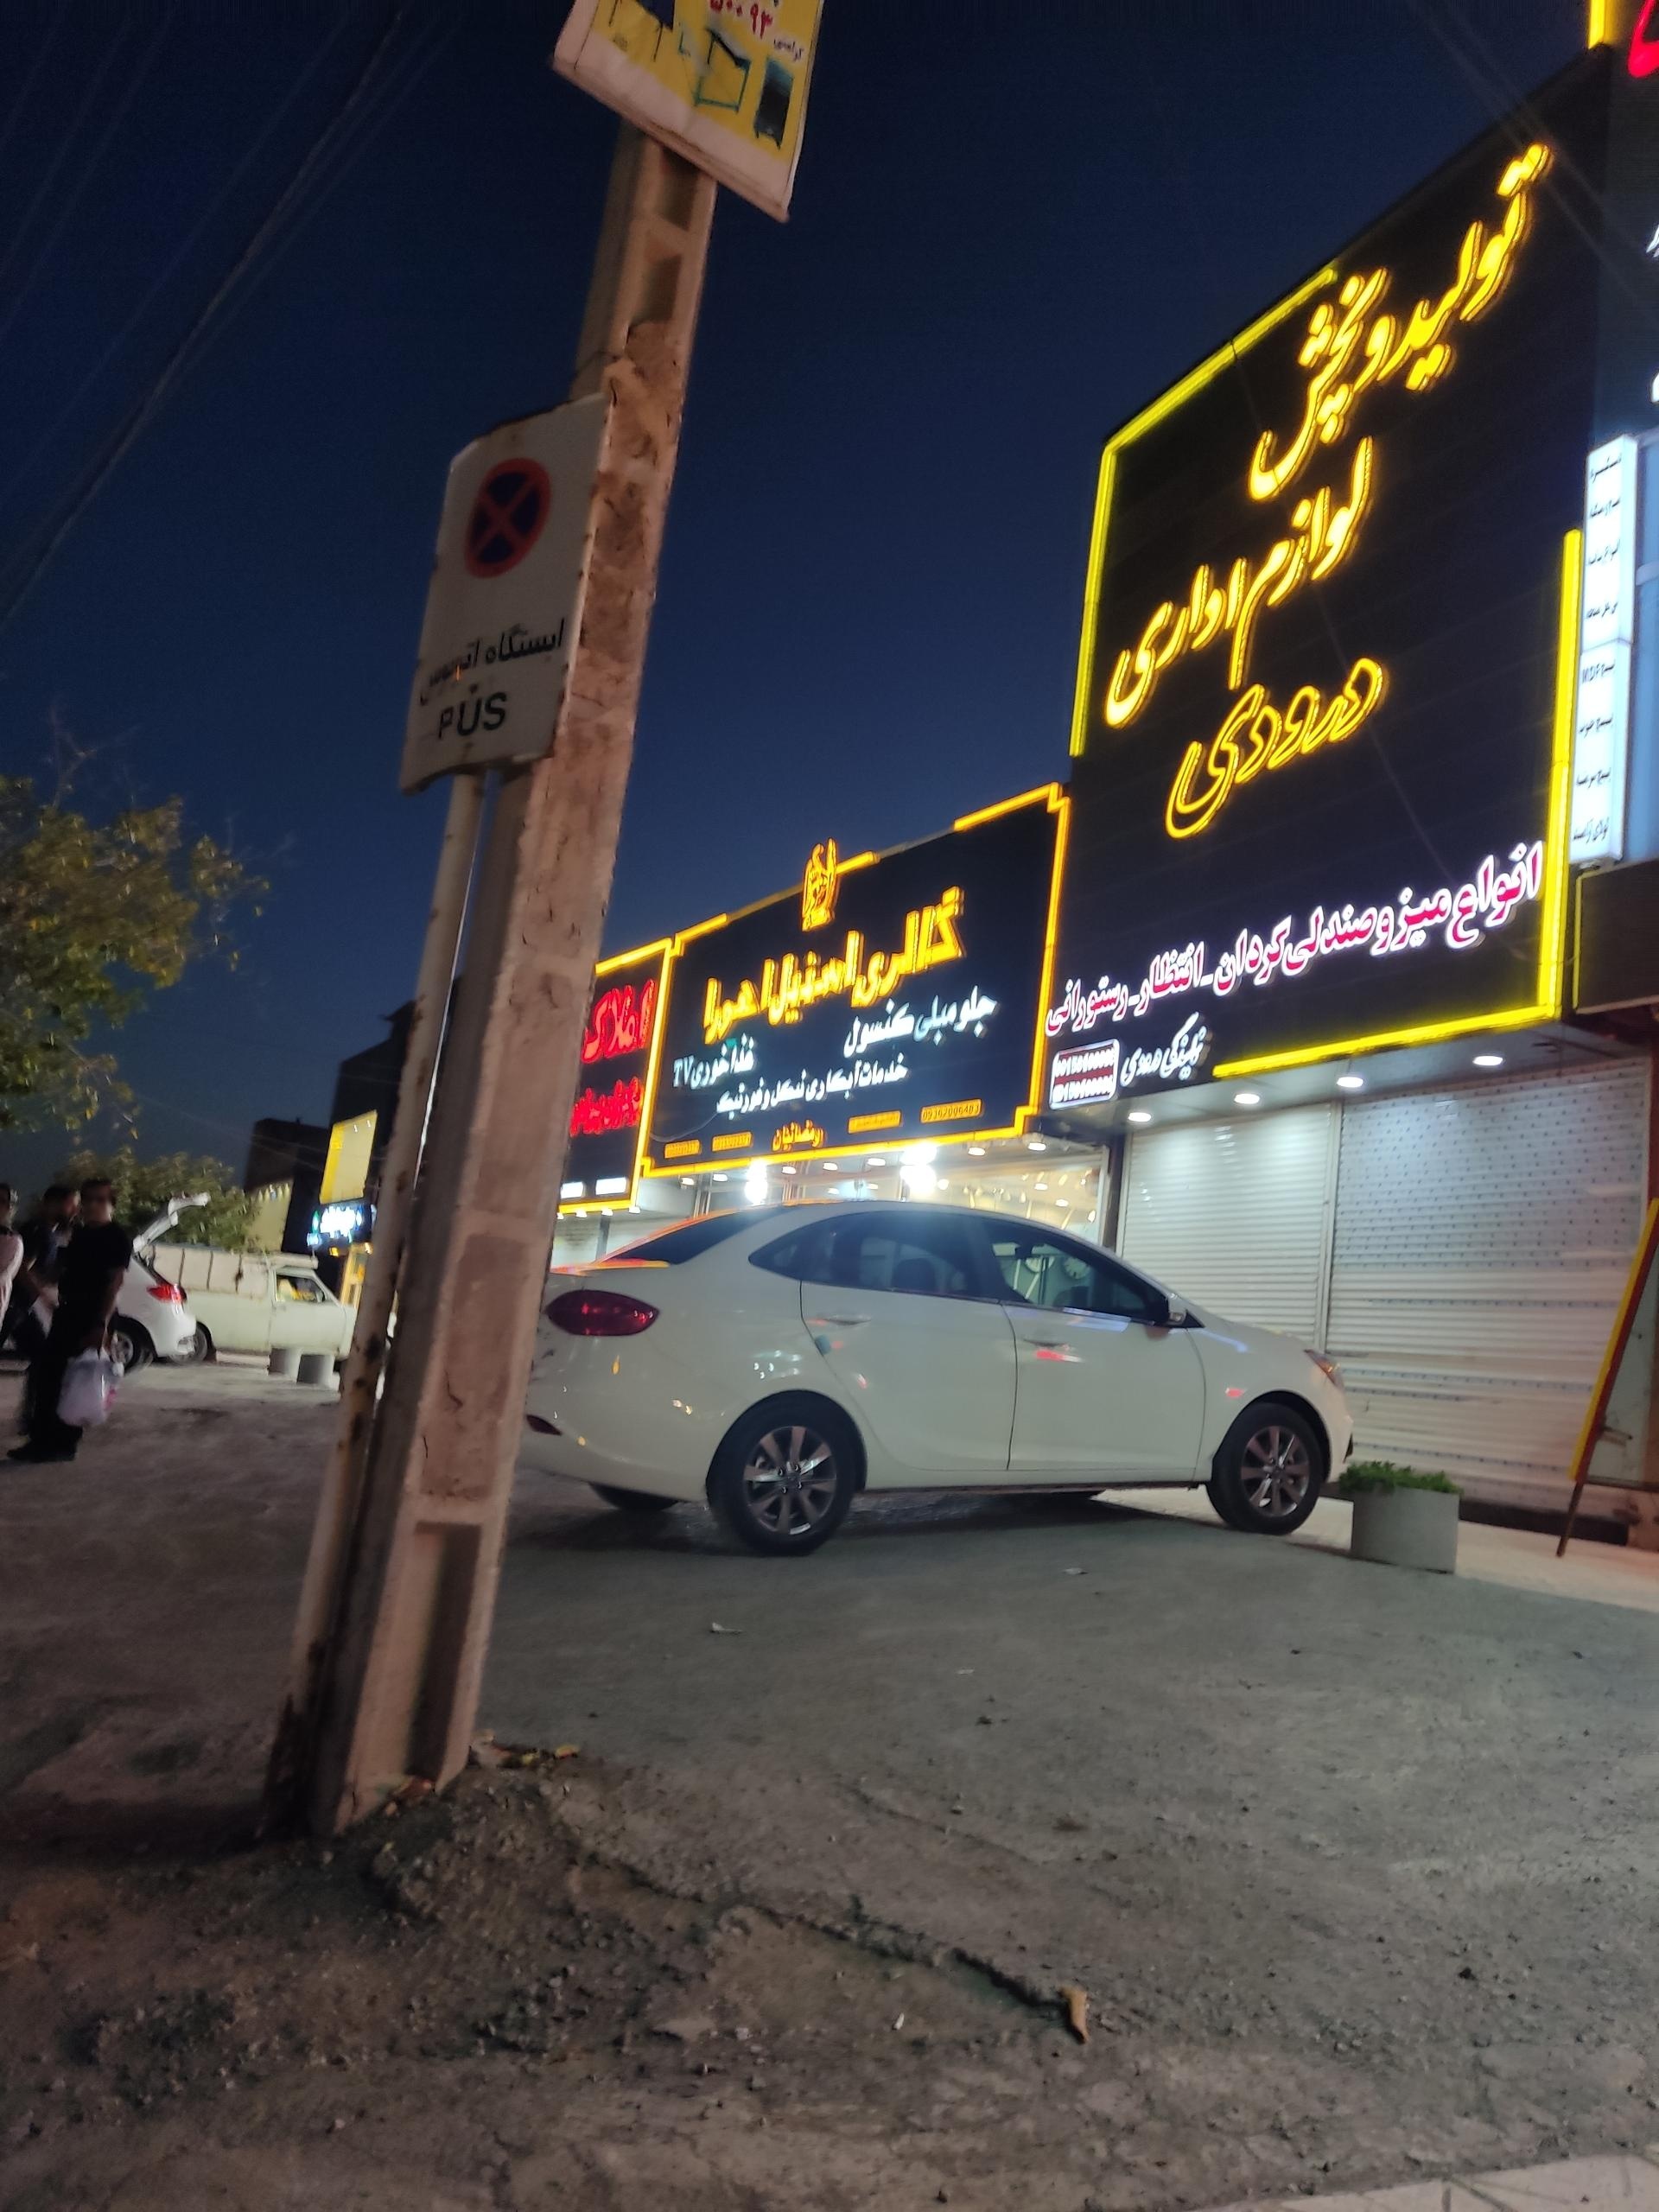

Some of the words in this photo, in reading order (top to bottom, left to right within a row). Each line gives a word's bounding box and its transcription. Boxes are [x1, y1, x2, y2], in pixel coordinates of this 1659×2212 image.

[1379, 142, 1554, 391] تولید
[1248, 268, 1389, 501] پخش
[1354, 314, 1397, 394] و
[1230, 436, 1374, 690] لوازم
[1105, 559, 1247, 728] اداری
[1165, 657, 1389, 840] درودی
[1370, 906, 1395, 956] و
[1389, 887, 1452, 951] میز
[1446, 840, 1543, 949] انواع
[1134, 940, 1205, 1017] انتظار
[1281, 905, 1378, 976] صندلی
[580, 978, 658, 1064] املاک
[842, 997, 916, 1059] کنسول
[912, 995, 958, 1046] مبلی
[952, 985, 999, 1038] جلو
[672, 1054, 695, 1088] TV
[857, 1052, 909, 1088] خدمات
